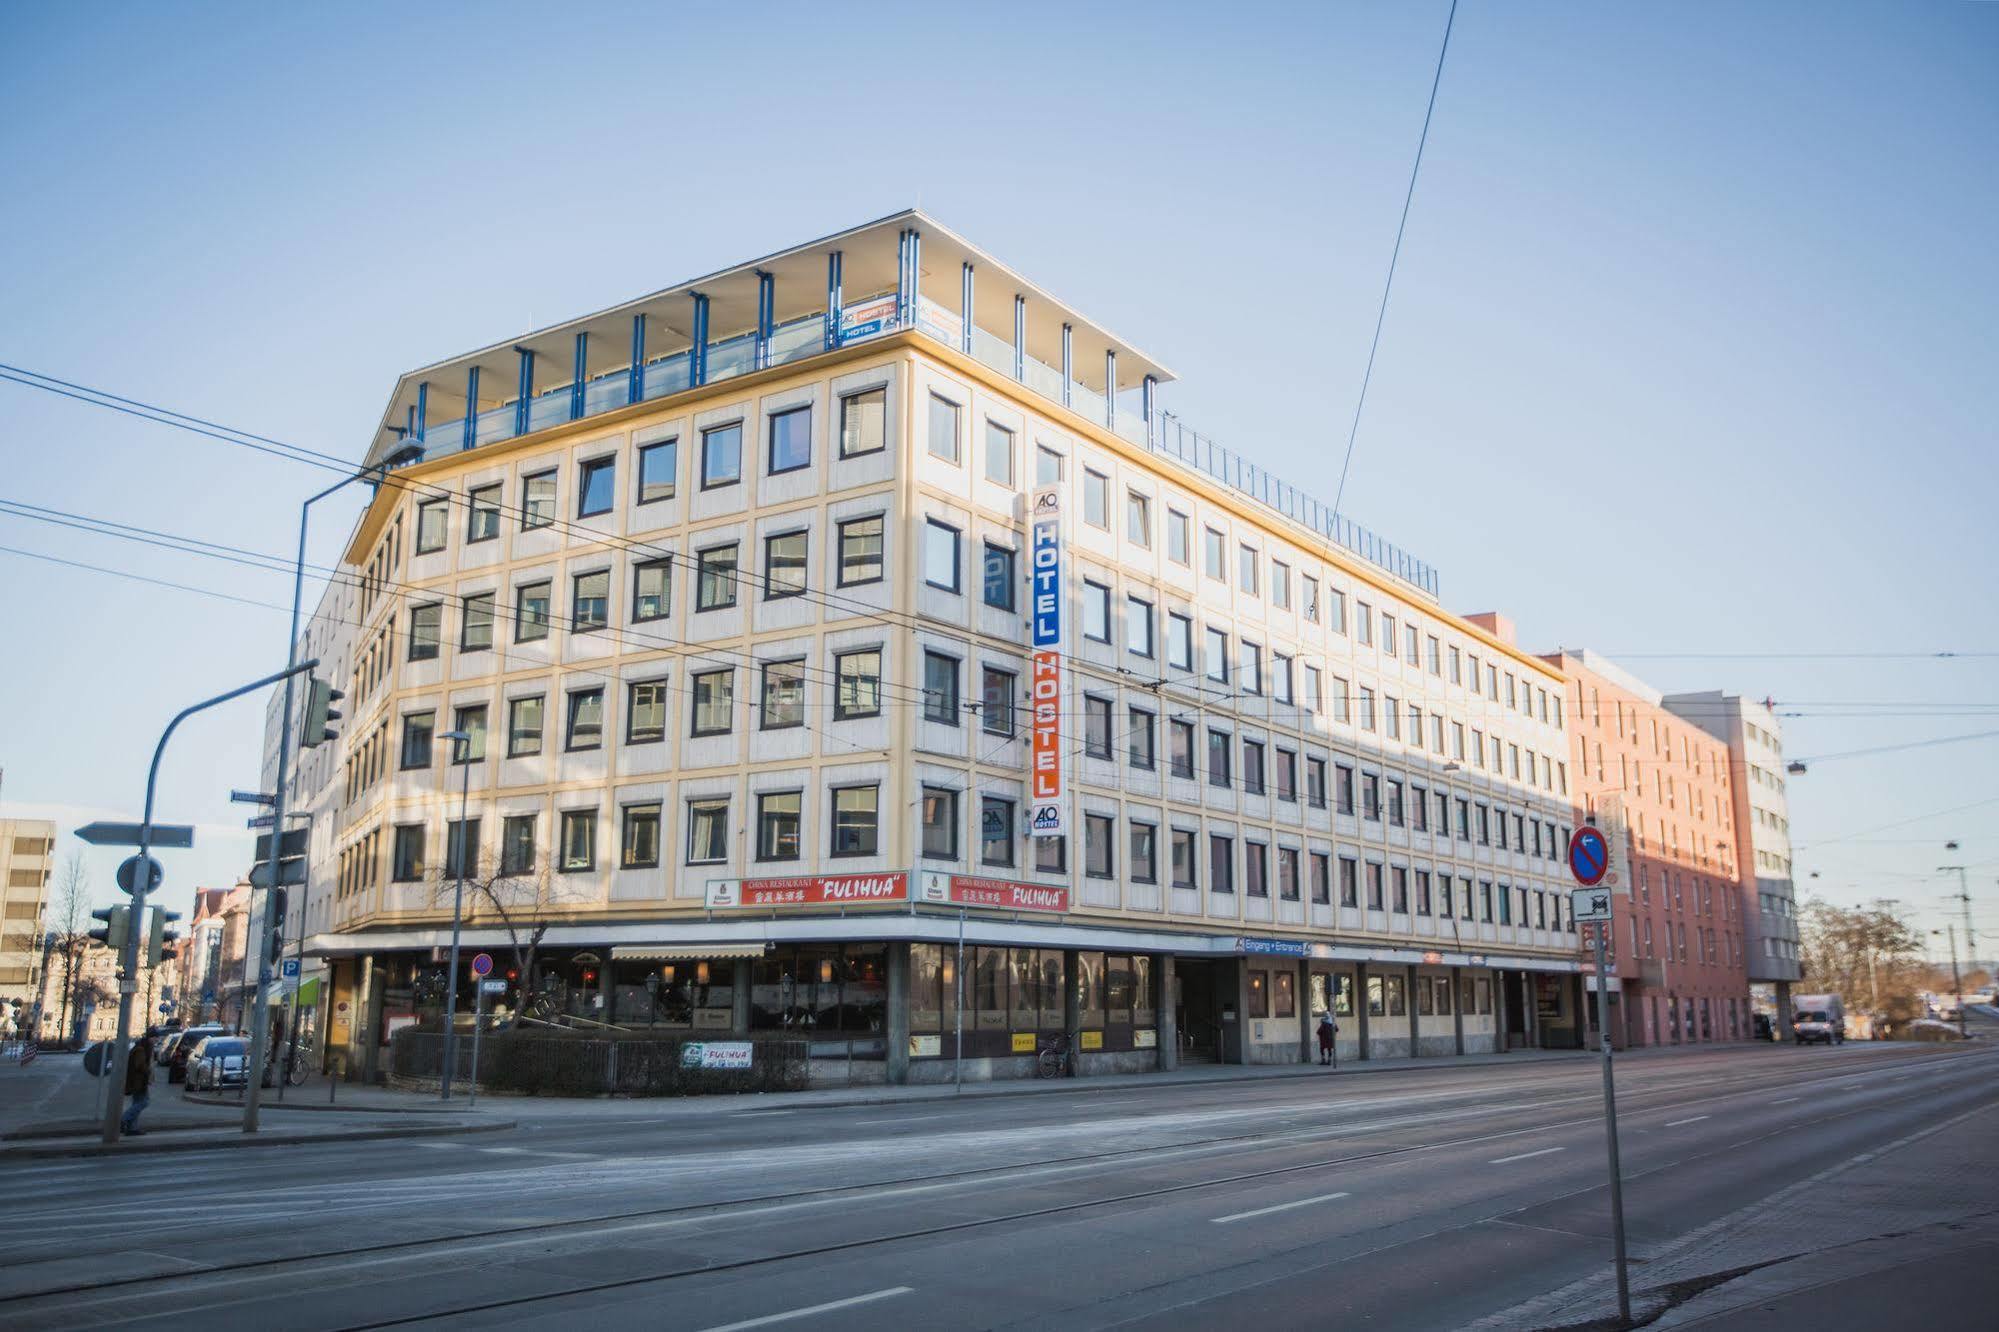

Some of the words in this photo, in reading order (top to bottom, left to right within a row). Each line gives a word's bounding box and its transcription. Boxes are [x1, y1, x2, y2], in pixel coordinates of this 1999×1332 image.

[846, 325, 876, 338] HOTEL
[1035, 523, 1058, 640] HOTEL
[1035, 656, 1058, 796] HOSTEL
[749, 879, 768, 889] CHINA
[770, 878, 812, 889] RESTAURANT
[1245, 939, 1270, 952] Eingang
[1275, 941, 1304, 953] Entrance
[286, 962, 297, 975] P
